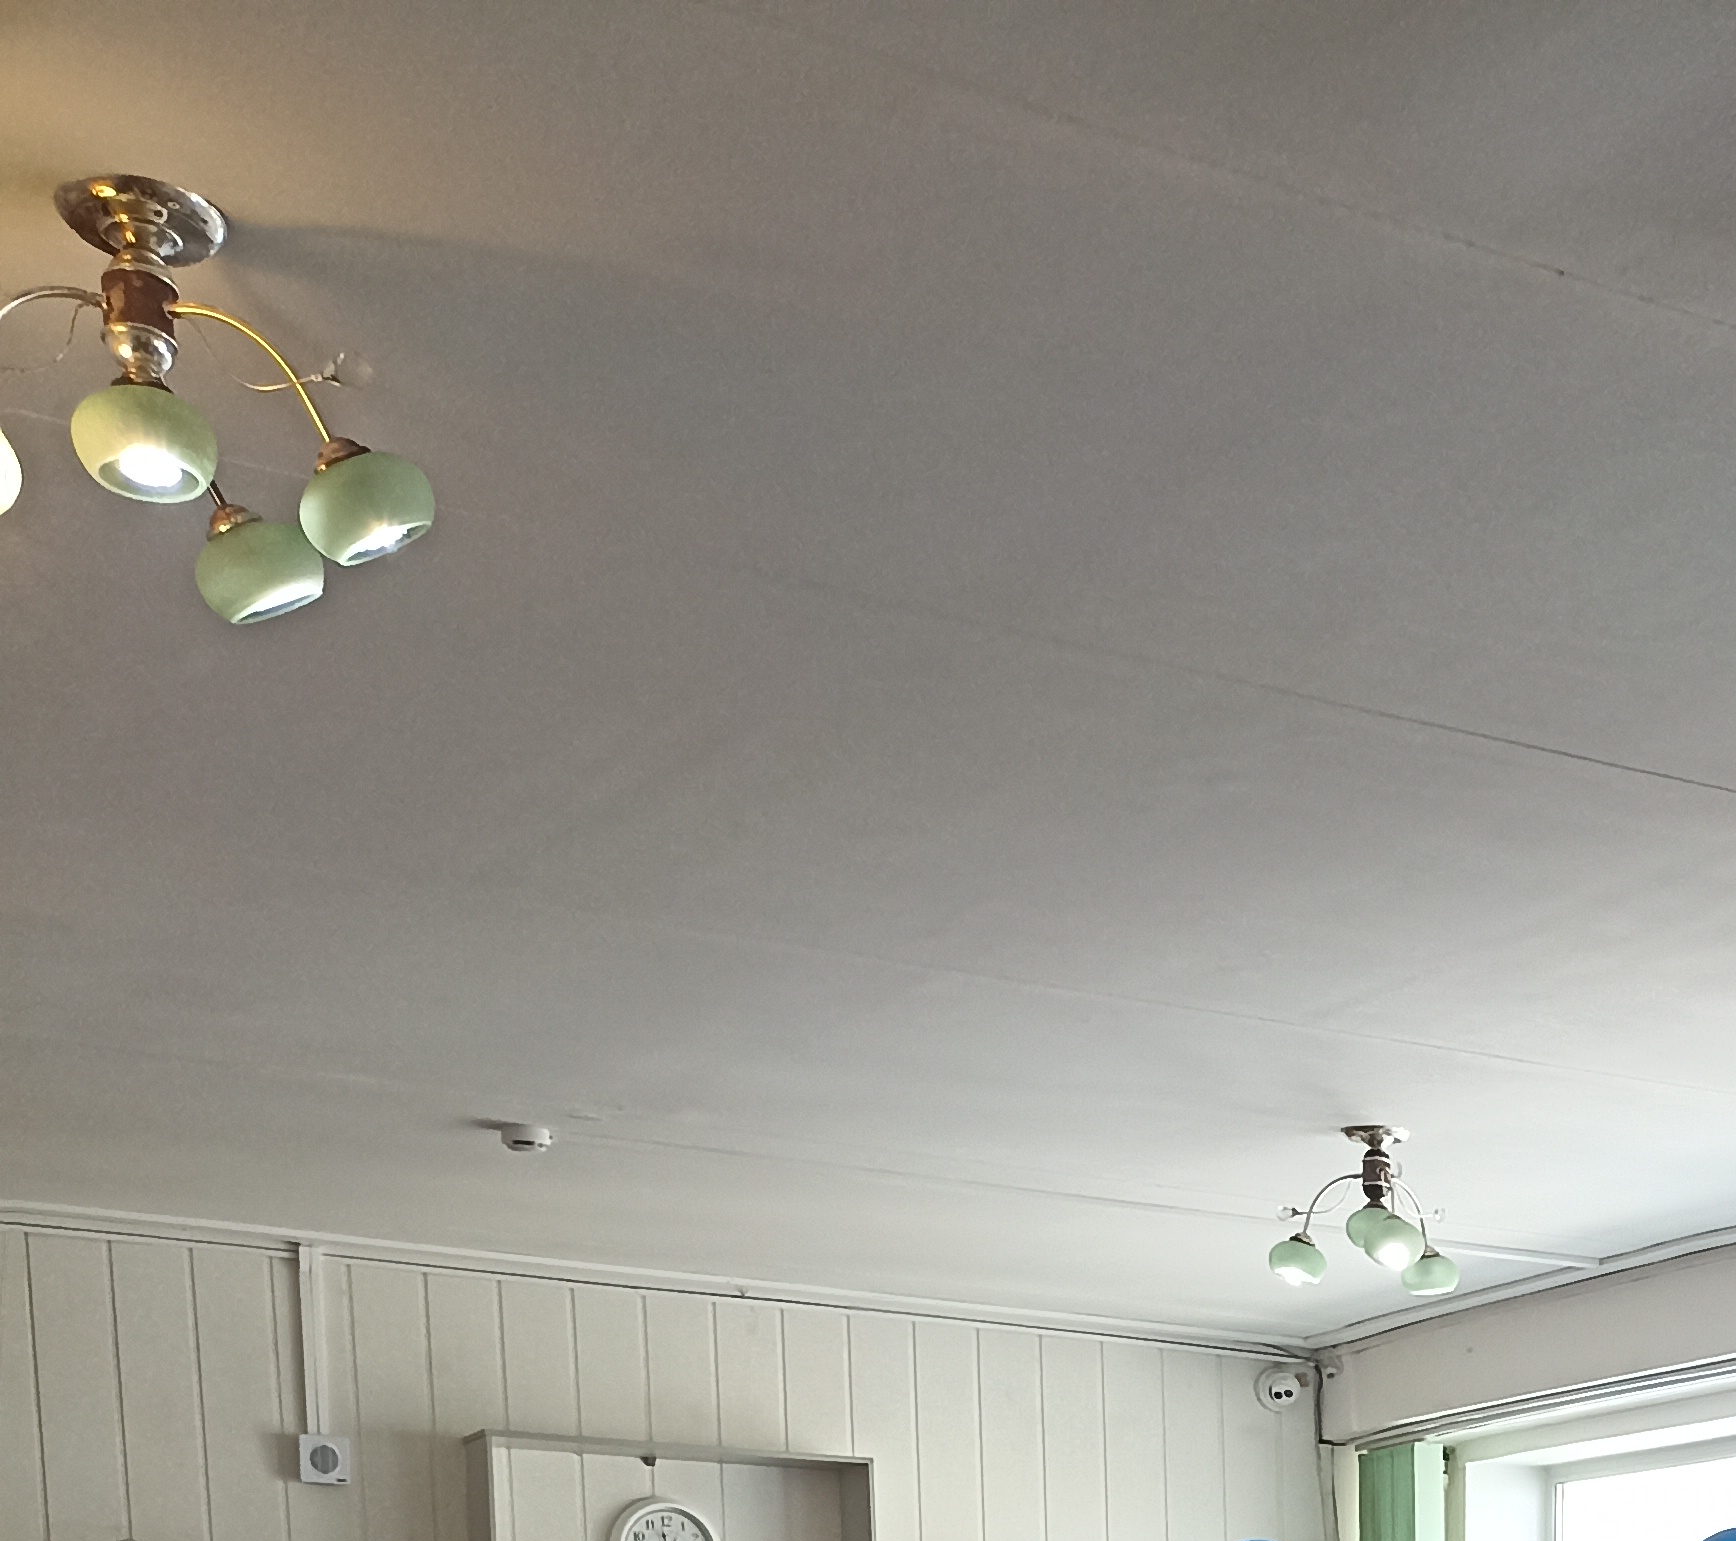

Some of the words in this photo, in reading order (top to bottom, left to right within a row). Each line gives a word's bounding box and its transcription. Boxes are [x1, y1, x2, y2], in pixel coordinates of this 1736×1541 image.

[645, 1519, 655, 1530] 11
[660, 1515, 672, 1527] 12
[633, 1531, 645, 1541] 10
